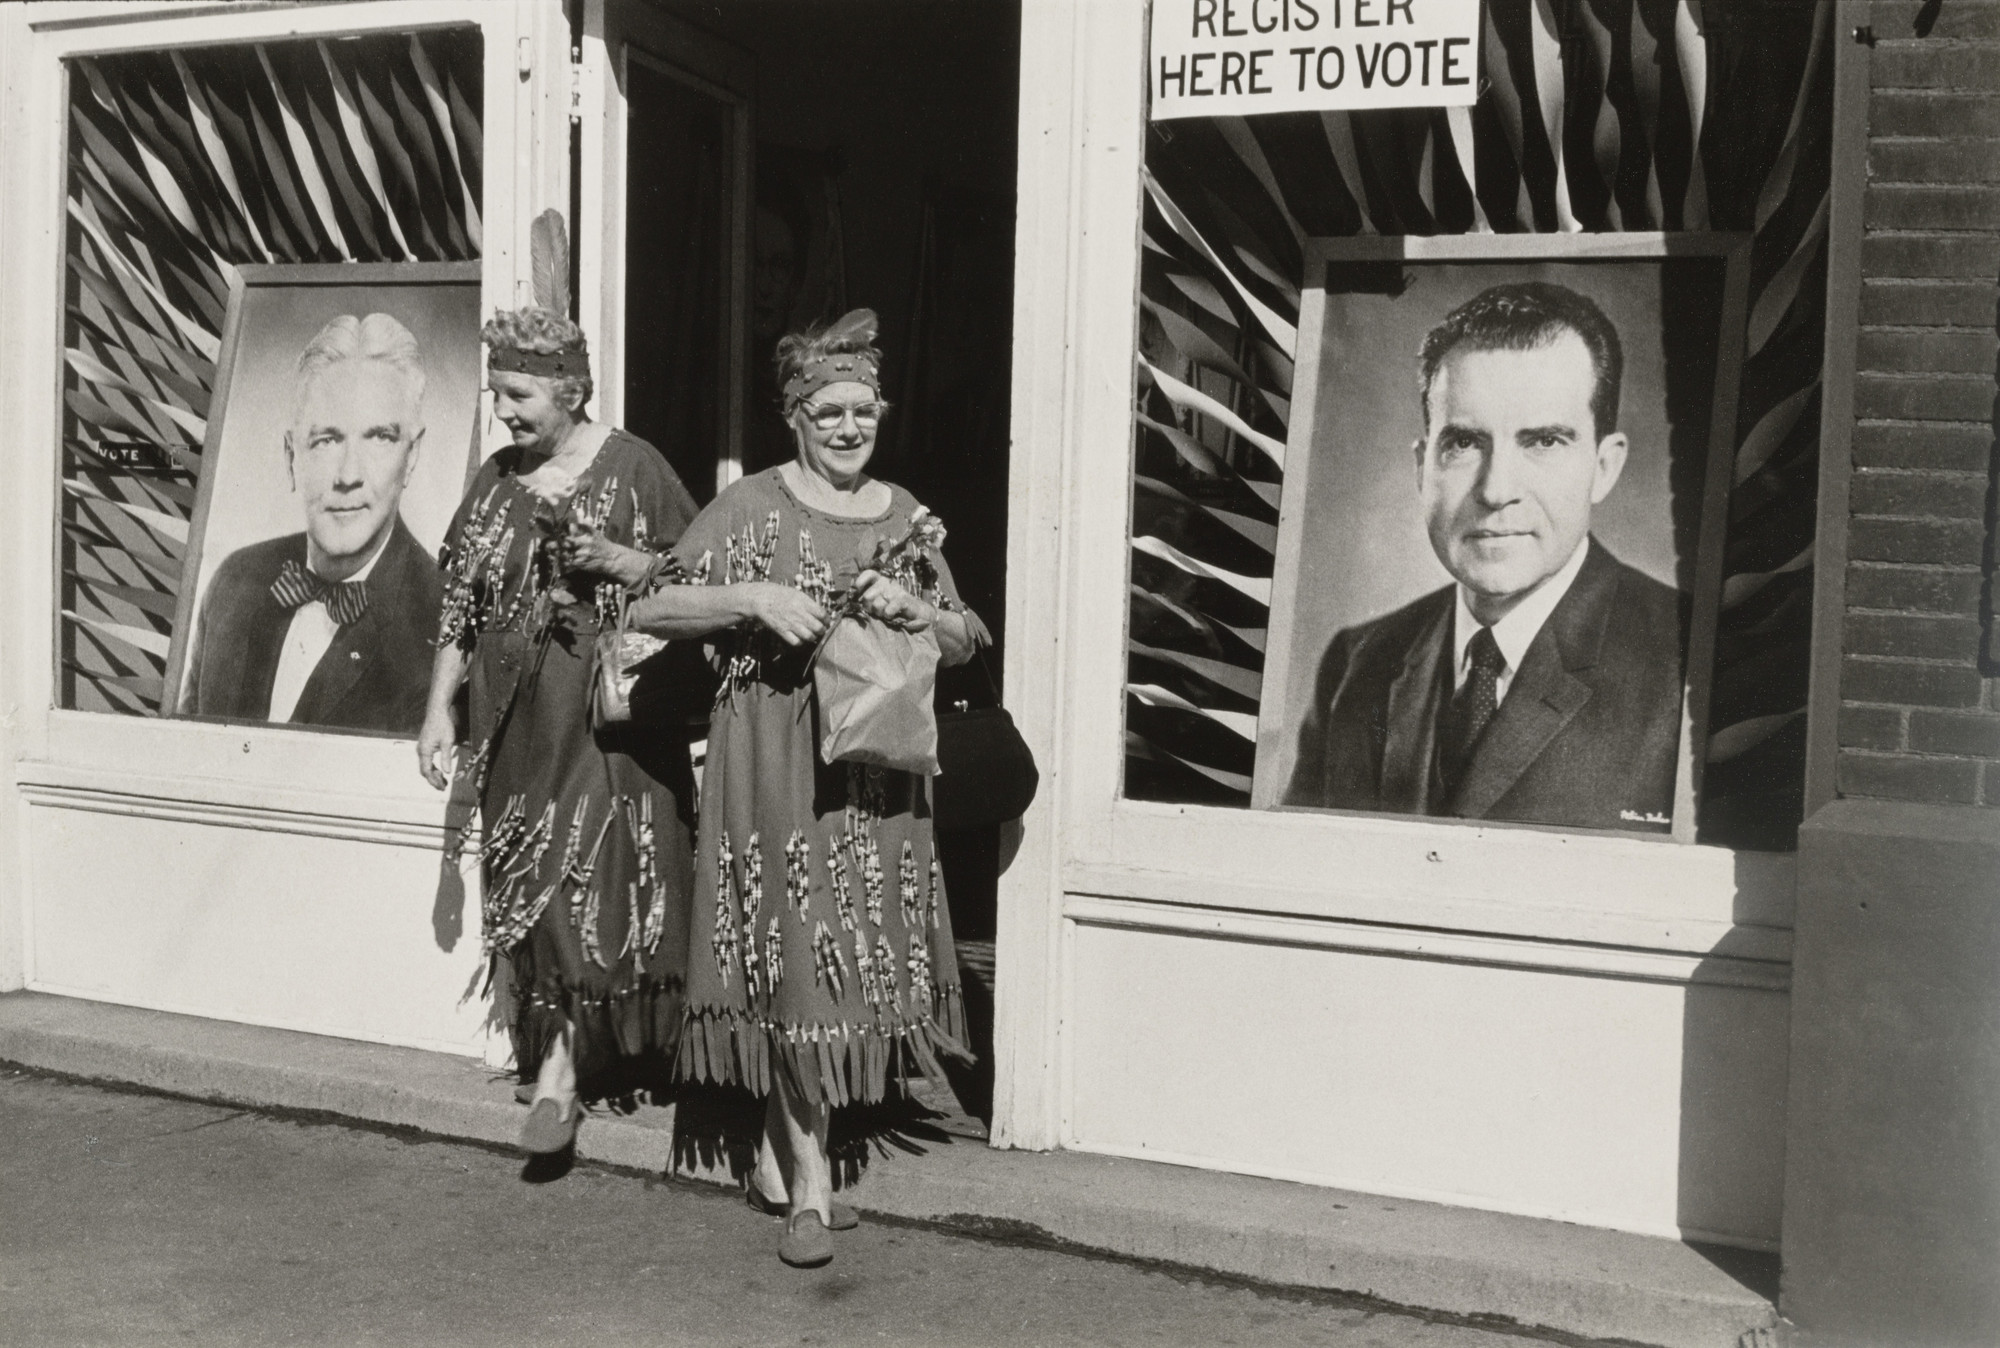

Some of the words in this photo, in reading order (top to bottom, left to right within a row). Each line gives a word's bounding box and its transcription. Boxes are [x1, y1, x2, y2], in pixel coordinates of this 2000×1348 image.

[1192, 0, 1415, 38] REGISTER
[1160, 49, 1274, 98] HERE
[1289, 45, 1345, 91] TO
[1355, 37, 1471, 88] VOTE
[99, 449, 139, 461] VOTE
